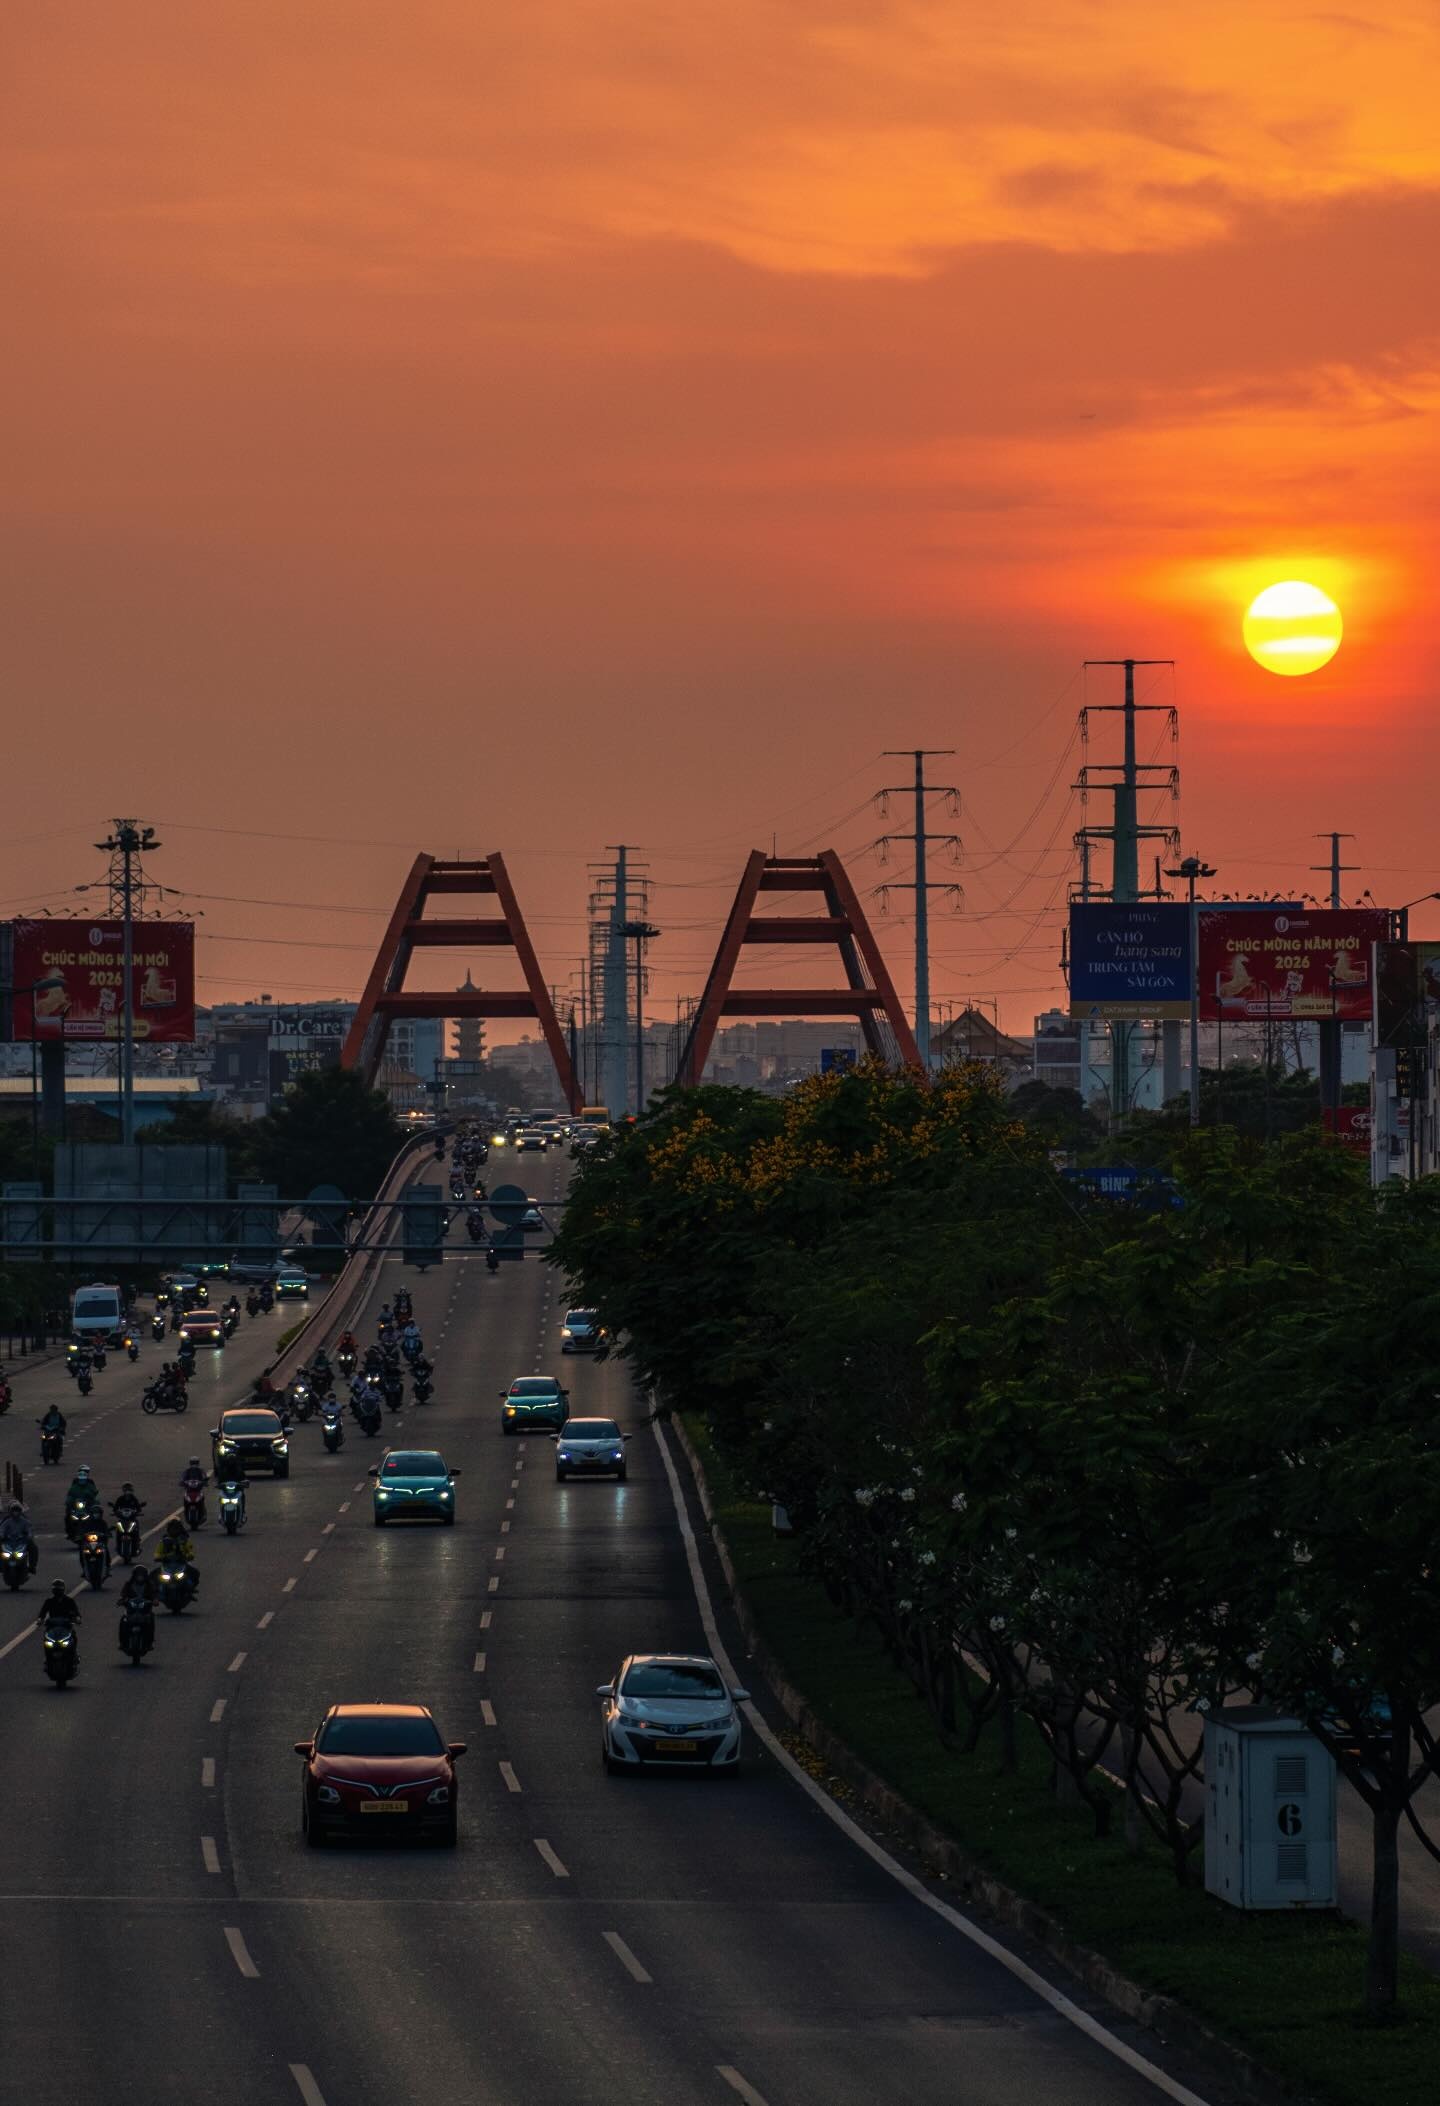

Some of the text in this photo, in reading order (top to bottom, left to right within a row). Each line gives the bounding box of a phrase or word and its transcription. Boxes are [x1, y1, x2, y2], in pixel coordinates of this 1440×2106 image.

[1225, 935, 1361, 952] CHÚC MỪNG NĂM MỚI
[42, 951, 77, 966] CHÚC
[78, 950, 115, 966] MỪNG
[145, 951, 169, 967] MỚI
[1273, 955, 1311, 969] 2026
[1088, 962, 1128, 973] TRUNG
[89, 971, 123, 986] 2026
[272, 1018, 341, 1035] Dr.Care
[1278, 1803, 1302, 1837] 6
